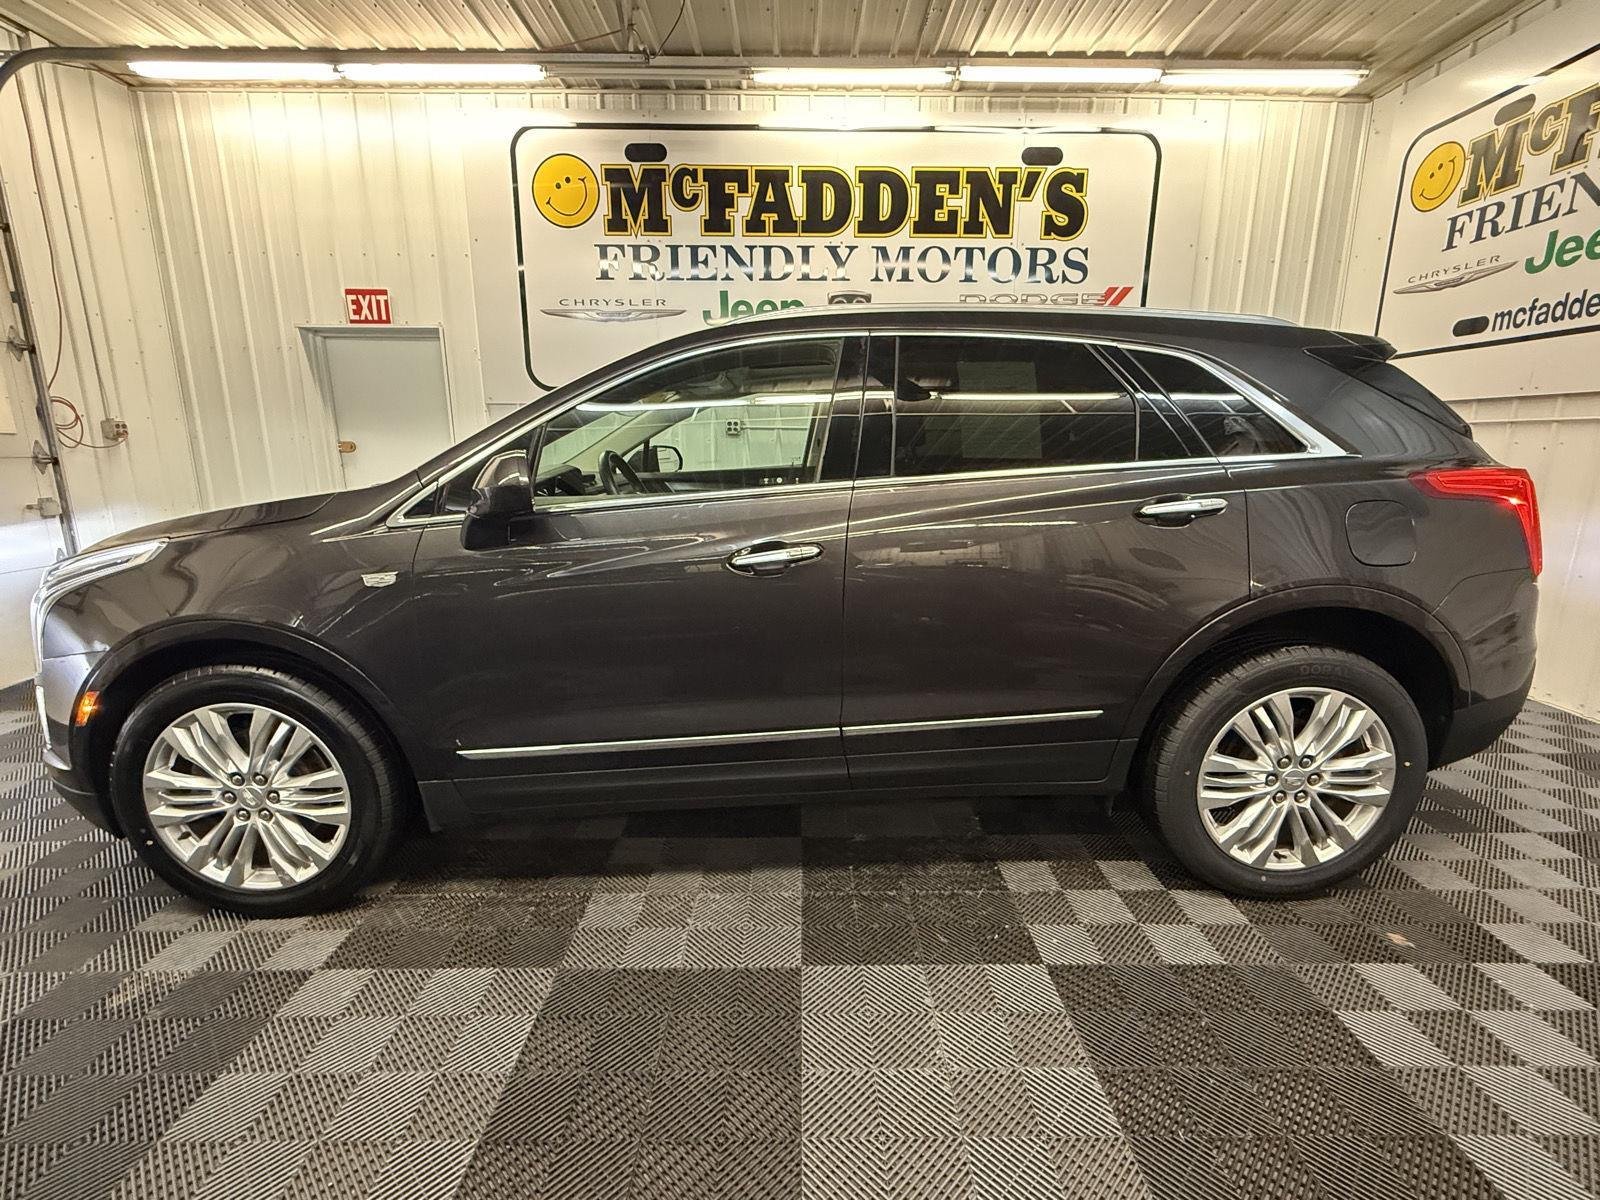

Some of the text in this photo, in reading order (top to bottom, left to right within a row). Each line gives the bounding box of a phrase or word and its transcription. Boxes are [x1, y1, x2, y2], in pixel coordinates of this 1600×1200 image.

[594, 244, 1089, 285] FRIENDLY MOTORS
[1407, 254, 1502, 284] CHRYSLER
[346, 294, 387, 321] EXIT
[558, 298, 667, 307] CHRYSLER
[1491, 289, 1600, 332] mcfadde
